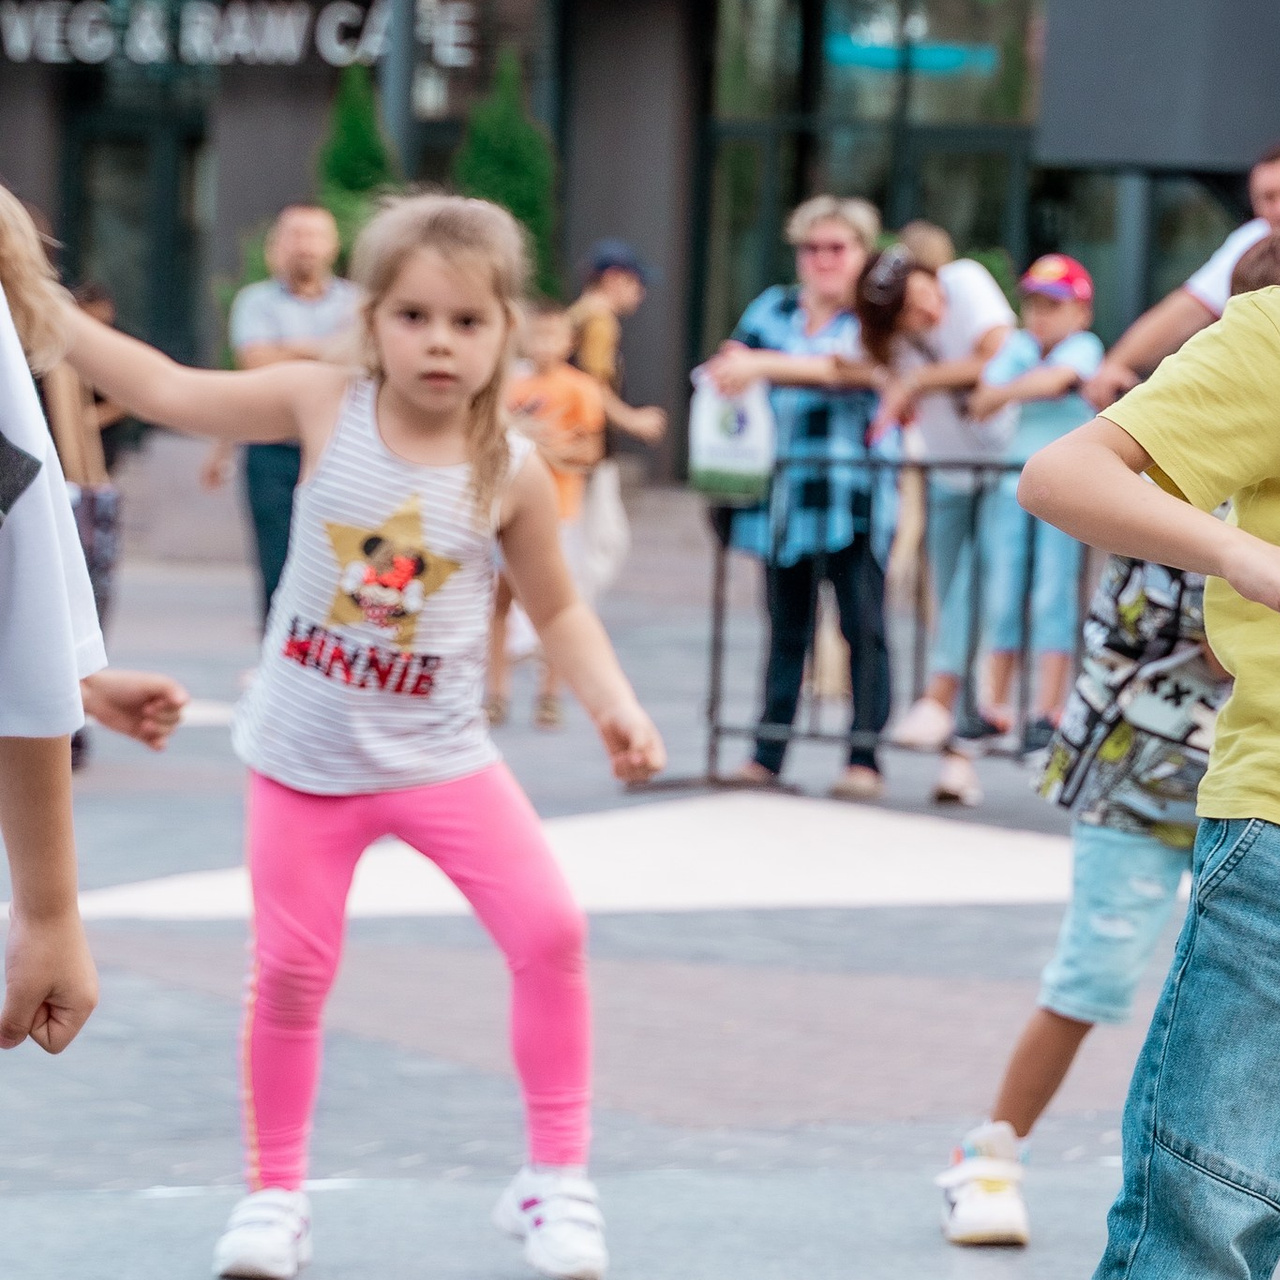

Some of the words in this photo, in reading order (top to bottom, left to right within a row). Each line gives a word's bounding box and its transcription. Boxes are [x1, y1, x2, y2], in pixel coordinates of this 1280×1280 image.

[124, 0, 171, 65] &
[178, 0, 312, 66] RAW
[315, 0, 475, 68] CAE
